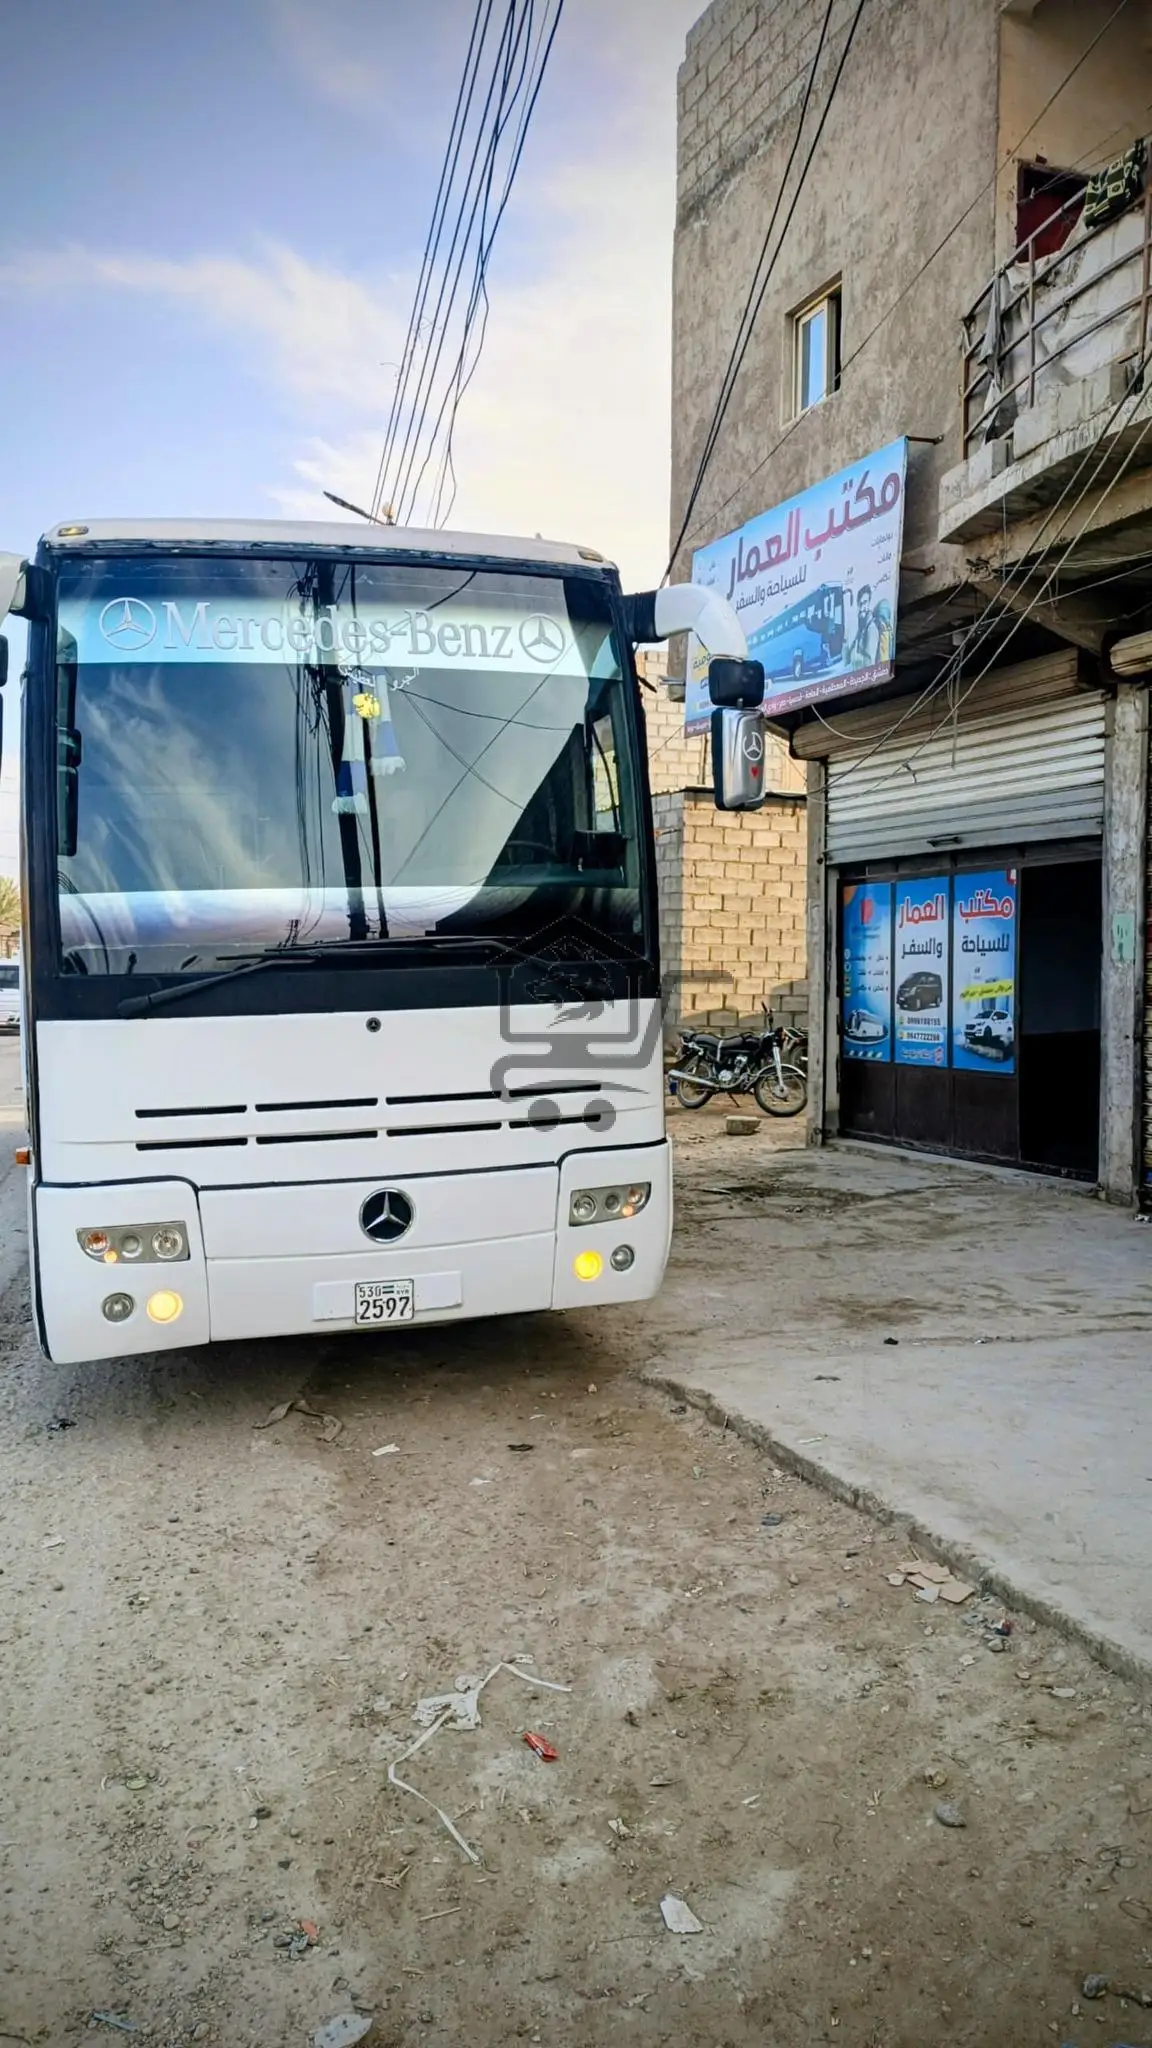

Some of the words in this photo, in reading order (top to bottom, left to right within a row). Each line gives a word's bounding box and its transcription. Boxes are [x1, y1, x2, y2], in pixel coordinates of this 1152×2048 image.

[804, 469, 901, 562] مكتب
[726, 507, 801, 601] العمار
[736, 584, 767, 613] والسفر
[766, 564, 807, 598] للسياحة
[161, 601, 514, 659] Mercedes-Benz
[899, 893, 945, 929] العمار
[959, 888, 1014, 924] مكتب
[901, 937, 942, 959] والسفر
[961, 933, 1009, 956] للسياحة
[360, 1296, 410, 1320] 2597
